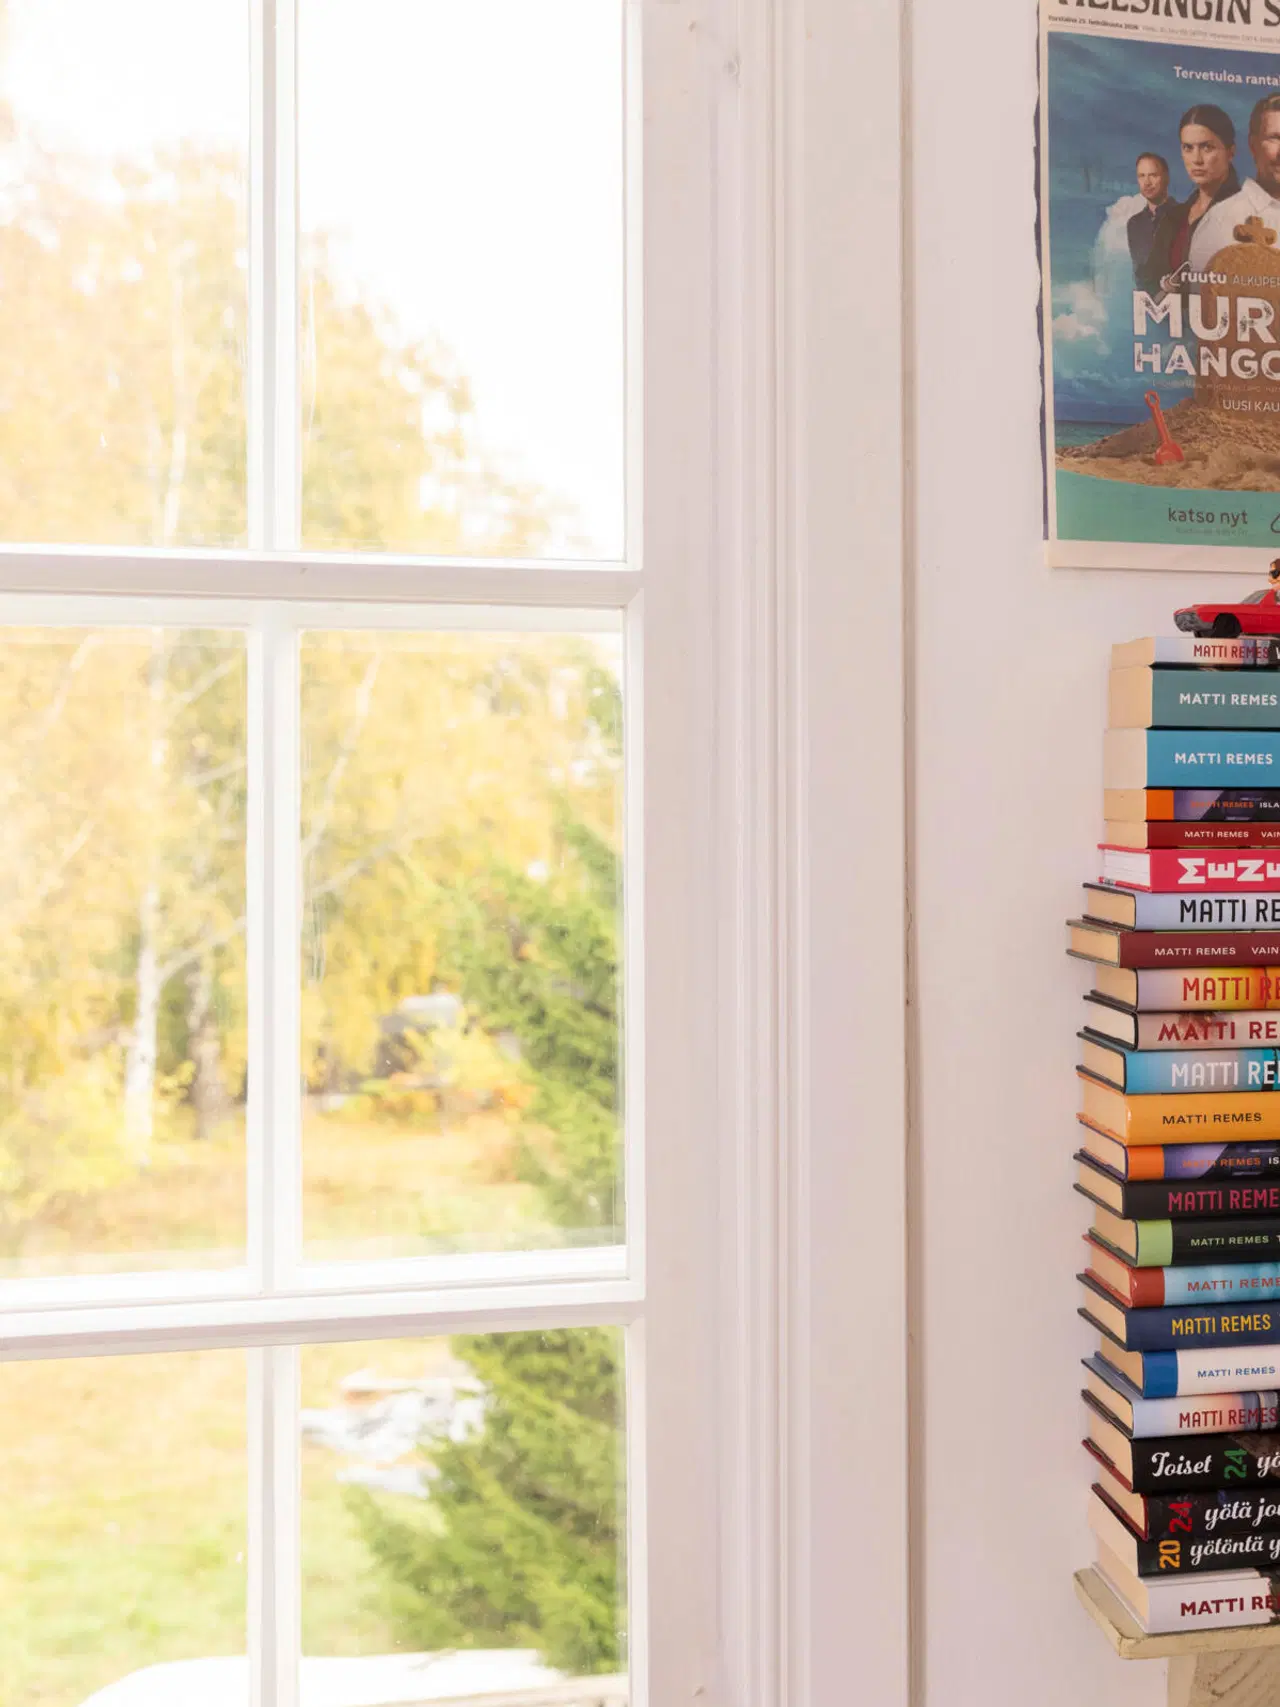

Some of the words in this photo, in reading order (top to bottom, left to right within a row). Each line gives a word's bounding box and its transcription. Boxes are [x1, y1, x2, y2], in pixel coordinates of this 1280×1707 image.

[1173, 65, 1243, 84] Tervetuloa
[1181, 270, 1228, 285] ruutu
[1222, 399, 1251, 412] UUSI
[1168, 507, 1215, 524] katso
[1220, 509, 1249, 527] nyt
[1193, 644, 1228, 658] MATTI
[1231, 645, 1269, 659] REMES
[1179, 692, 1226, 706] MATTI
[1230, 693, 1278, 706] REMES
[1174, 751, 1222, 765] MATTI
[1226, 752, 1273, 766] REMES
[1223, 801, 1254, 809] REMES
[1179, 899, 1247, 923] MATTI
[1154, 946, 1193, 957] MATTI
[1196, 945, 1236, 956] REMES
[1251, 945, 1280, 955] VAIN
[1183, 976, 1251, 1002] MATTI
[1158, 1019, 1236, 1041] MATTI
[1171, 1062, 1239, 1087] MATTI
[1162, 1114, 1208, 1125] MATTI
[1213, 1112, 1262, 1124] REMES
[1220, 1157, 1261, 1167] REMES
[1168, 1190, 1223, 1213] MATTI
[1190, 1237, 1225, 1247] MATTI
[1229, 1235, 1270, 1245] REMES
[1187, 1279, 1234, 1292] MATTI
[1171, 1317, 1216, 1336] MATTI
[1221, 1314, 1271, 1333] REMES
[1197, 1369, 1232, 1378] MATTI
[1235, 1366, 1276, 1376] REMES
[1179, 1410, 1223, 1429] MATTI
[1228, 1407, 1278, 1426] REMES
[1151, 1451, 1212, 1479] Toiset
[1224, 1449, 1247, 1479] 24
[1169, 1502, 1193, 1533] 24
[1204, 1502, 1250, 1531] yötä
[1160, 1540, 1181, 1568] 20
[1190, 1535, 1264, 1566] yötöntä
[1180, 1598, 1245, 1616] MATTI
